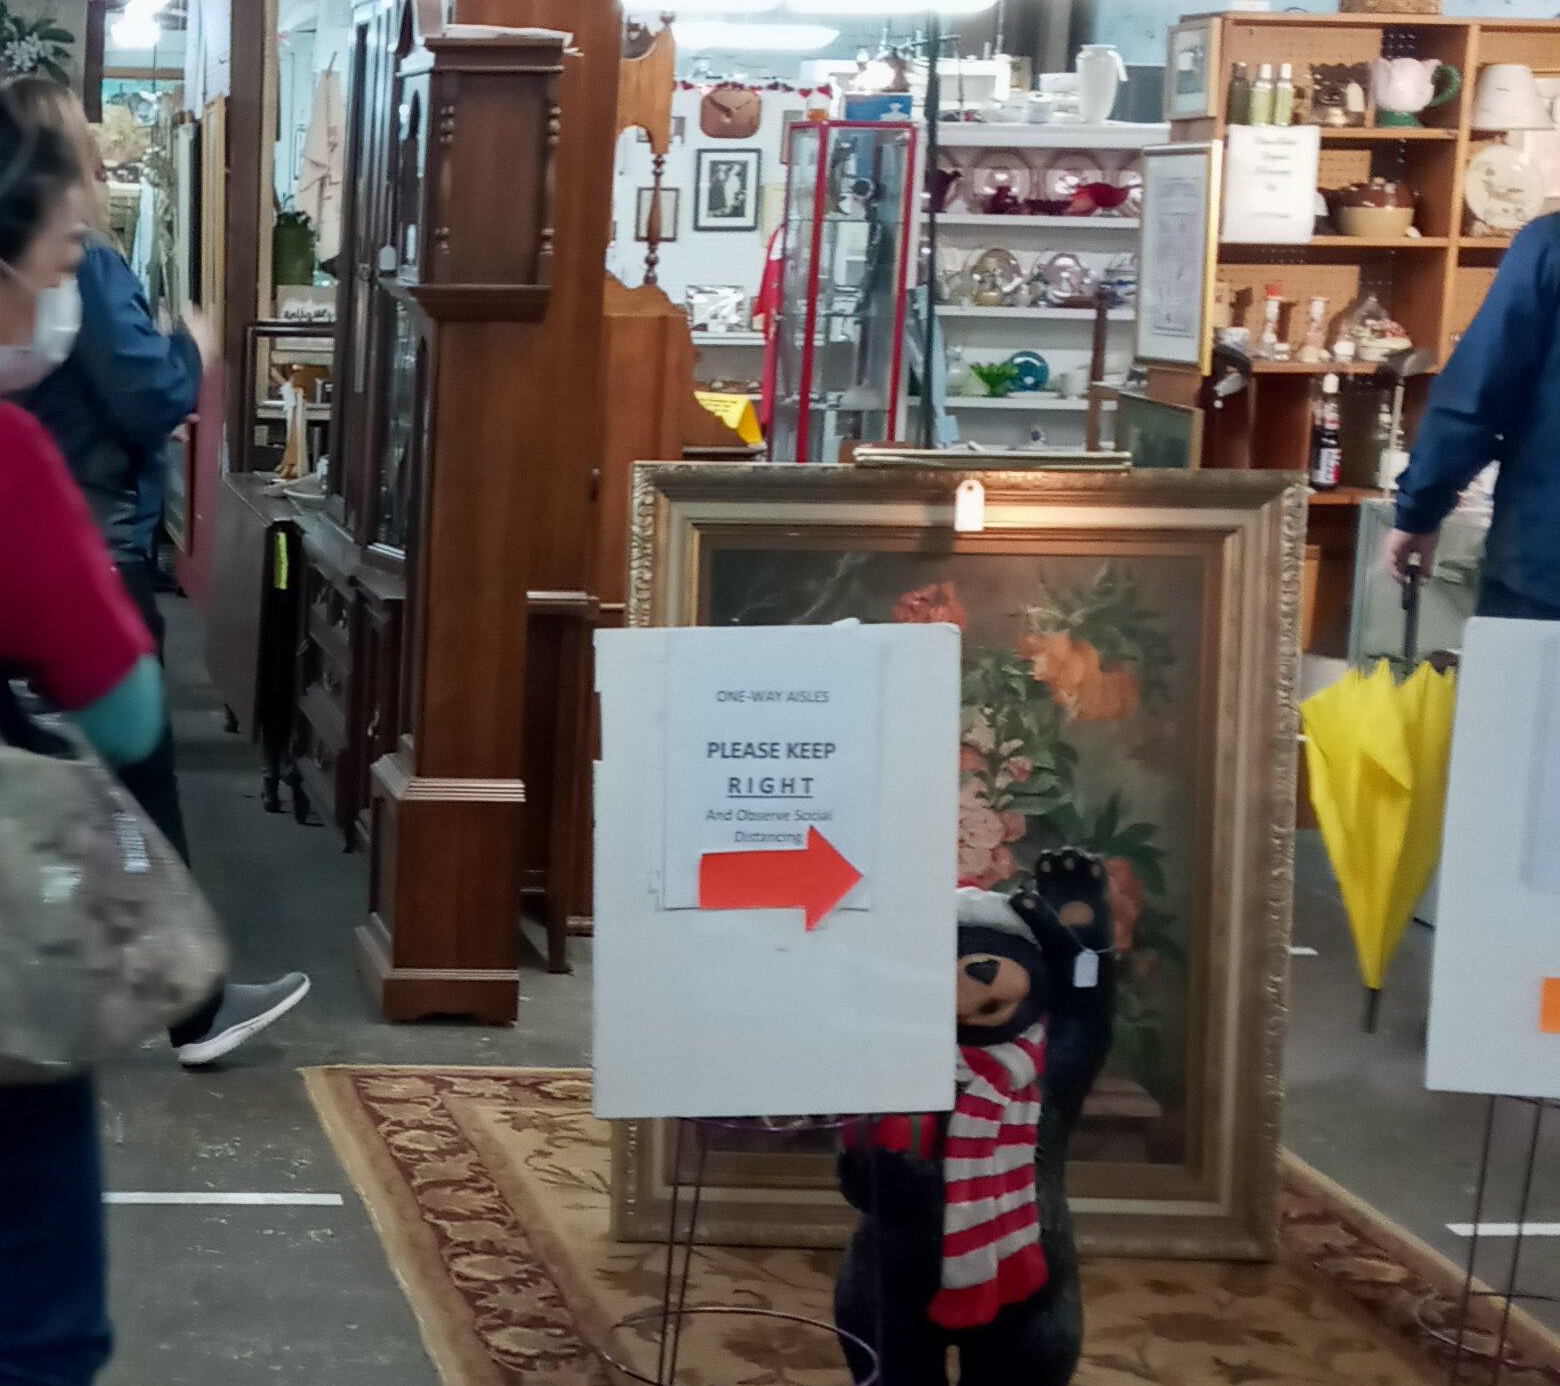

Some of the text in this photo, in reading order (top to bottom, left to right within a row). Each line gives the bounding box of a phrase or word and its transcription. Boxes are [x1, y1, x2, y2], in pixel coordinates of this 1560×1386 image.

[716, 690, 830, 703] ONE-WAY AISLES
[706, 742, 837, 760] PLEASE KEEP
[727, 776, 815, 795] RIGHT
[705, 809, 834, 822] And Observe Social
[734, 831, 804, 846] Distancing
